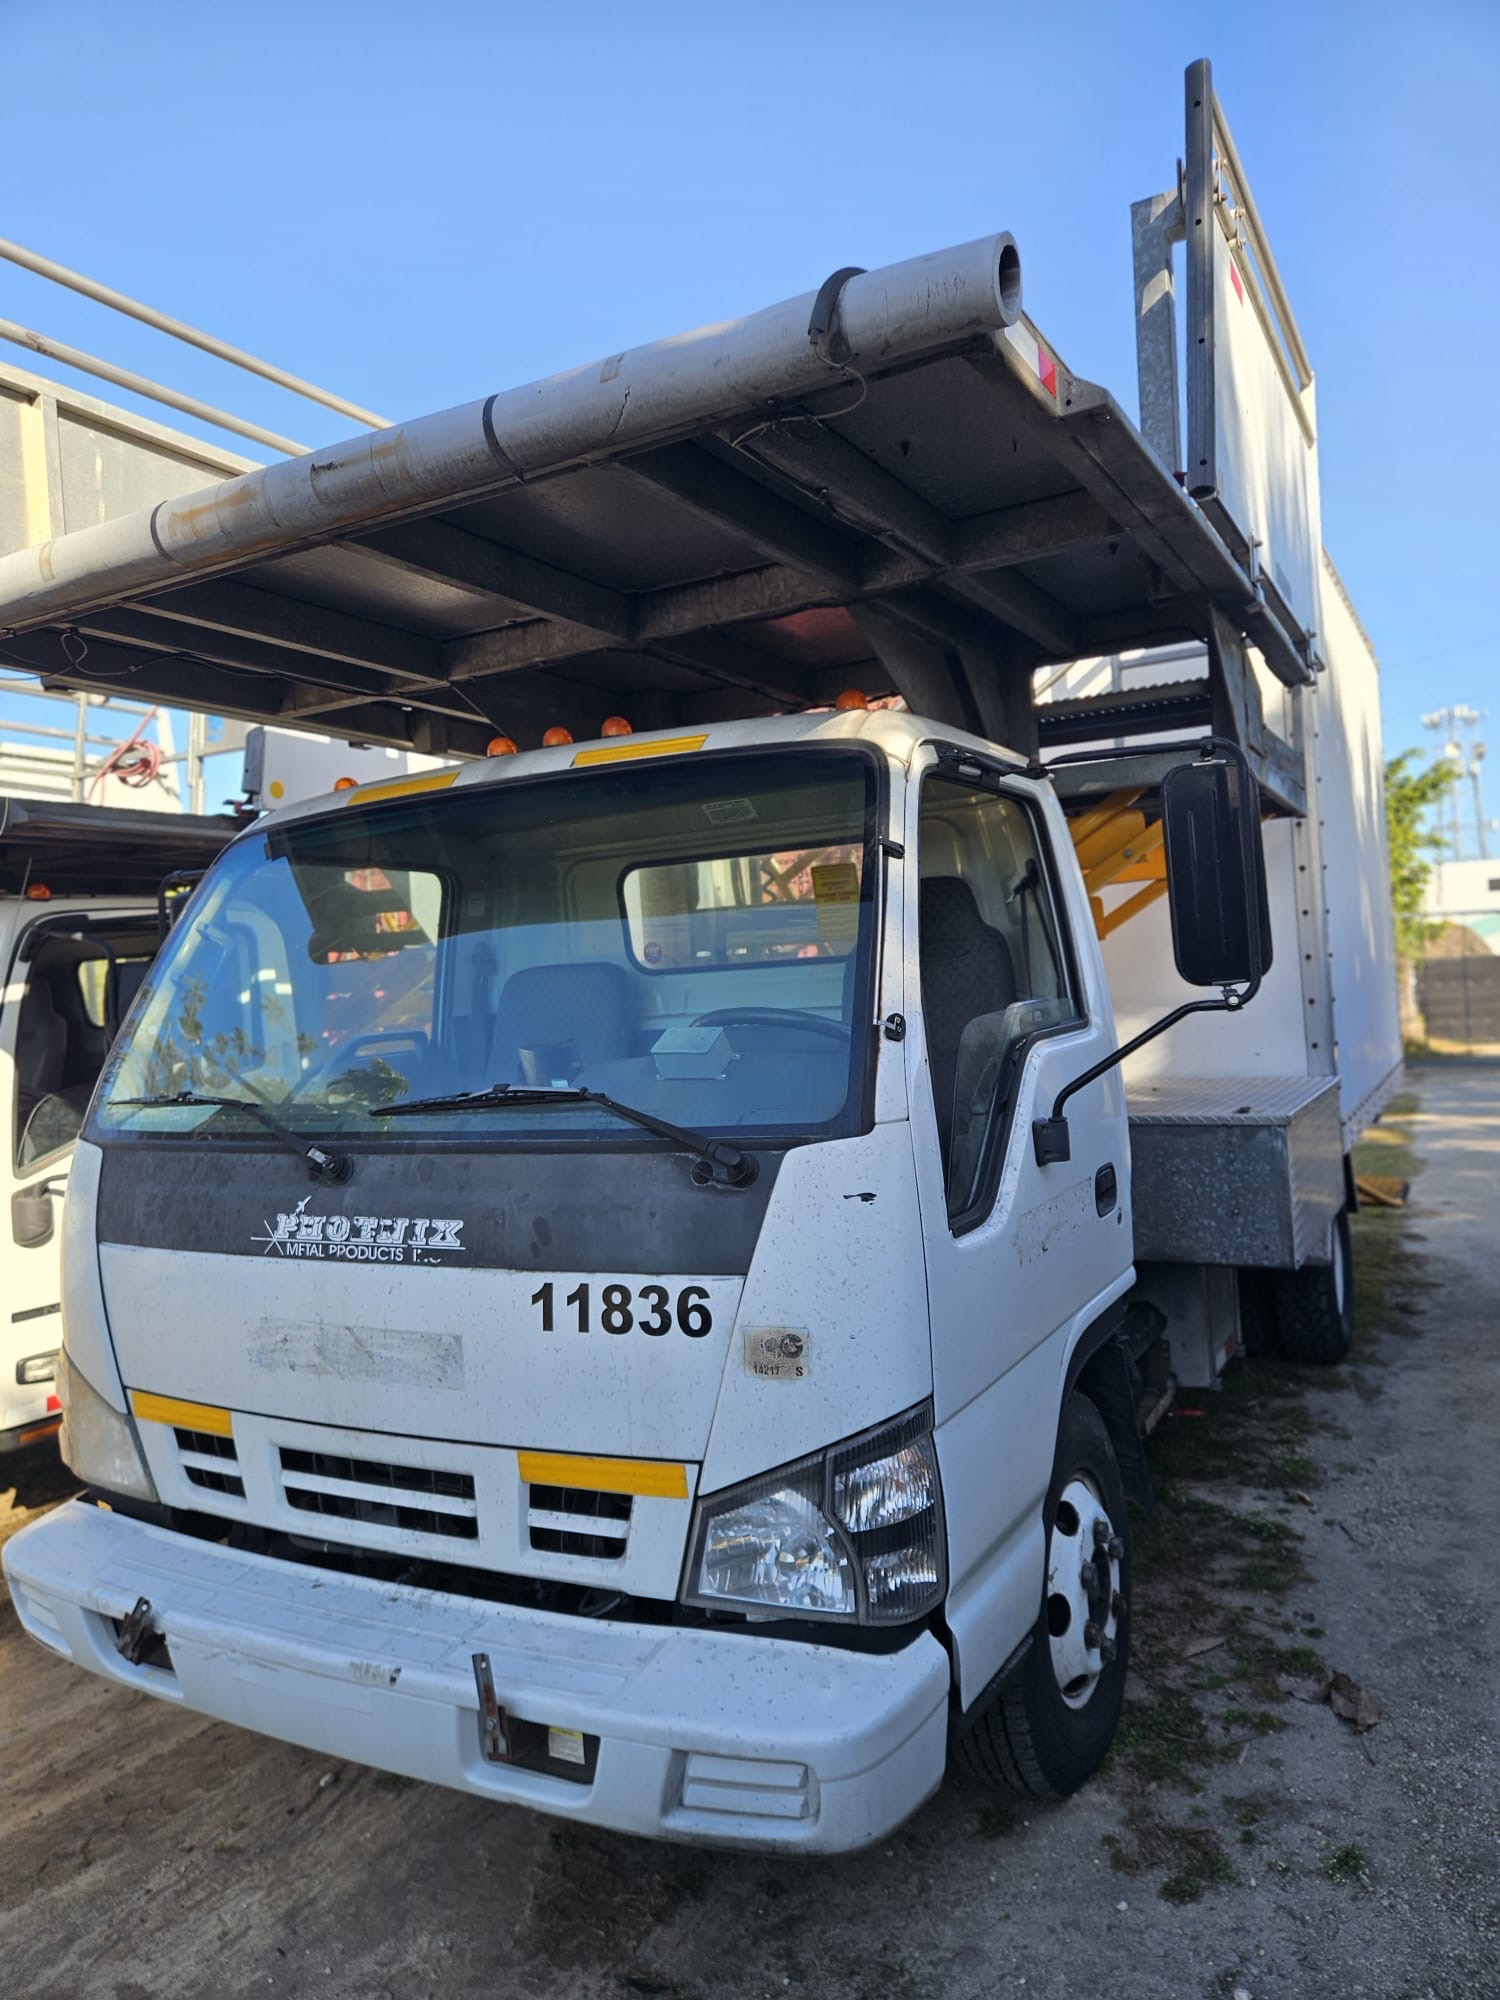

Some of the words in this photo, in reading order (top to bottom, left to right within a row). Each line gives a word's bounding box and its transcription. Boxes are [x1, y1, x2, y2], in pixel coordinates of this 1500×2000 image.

[274, 1213, 463, 1247] PHOENIX
[531, 1282, 712, 1338] 11836
[795, 1366, 803, 1377] S
